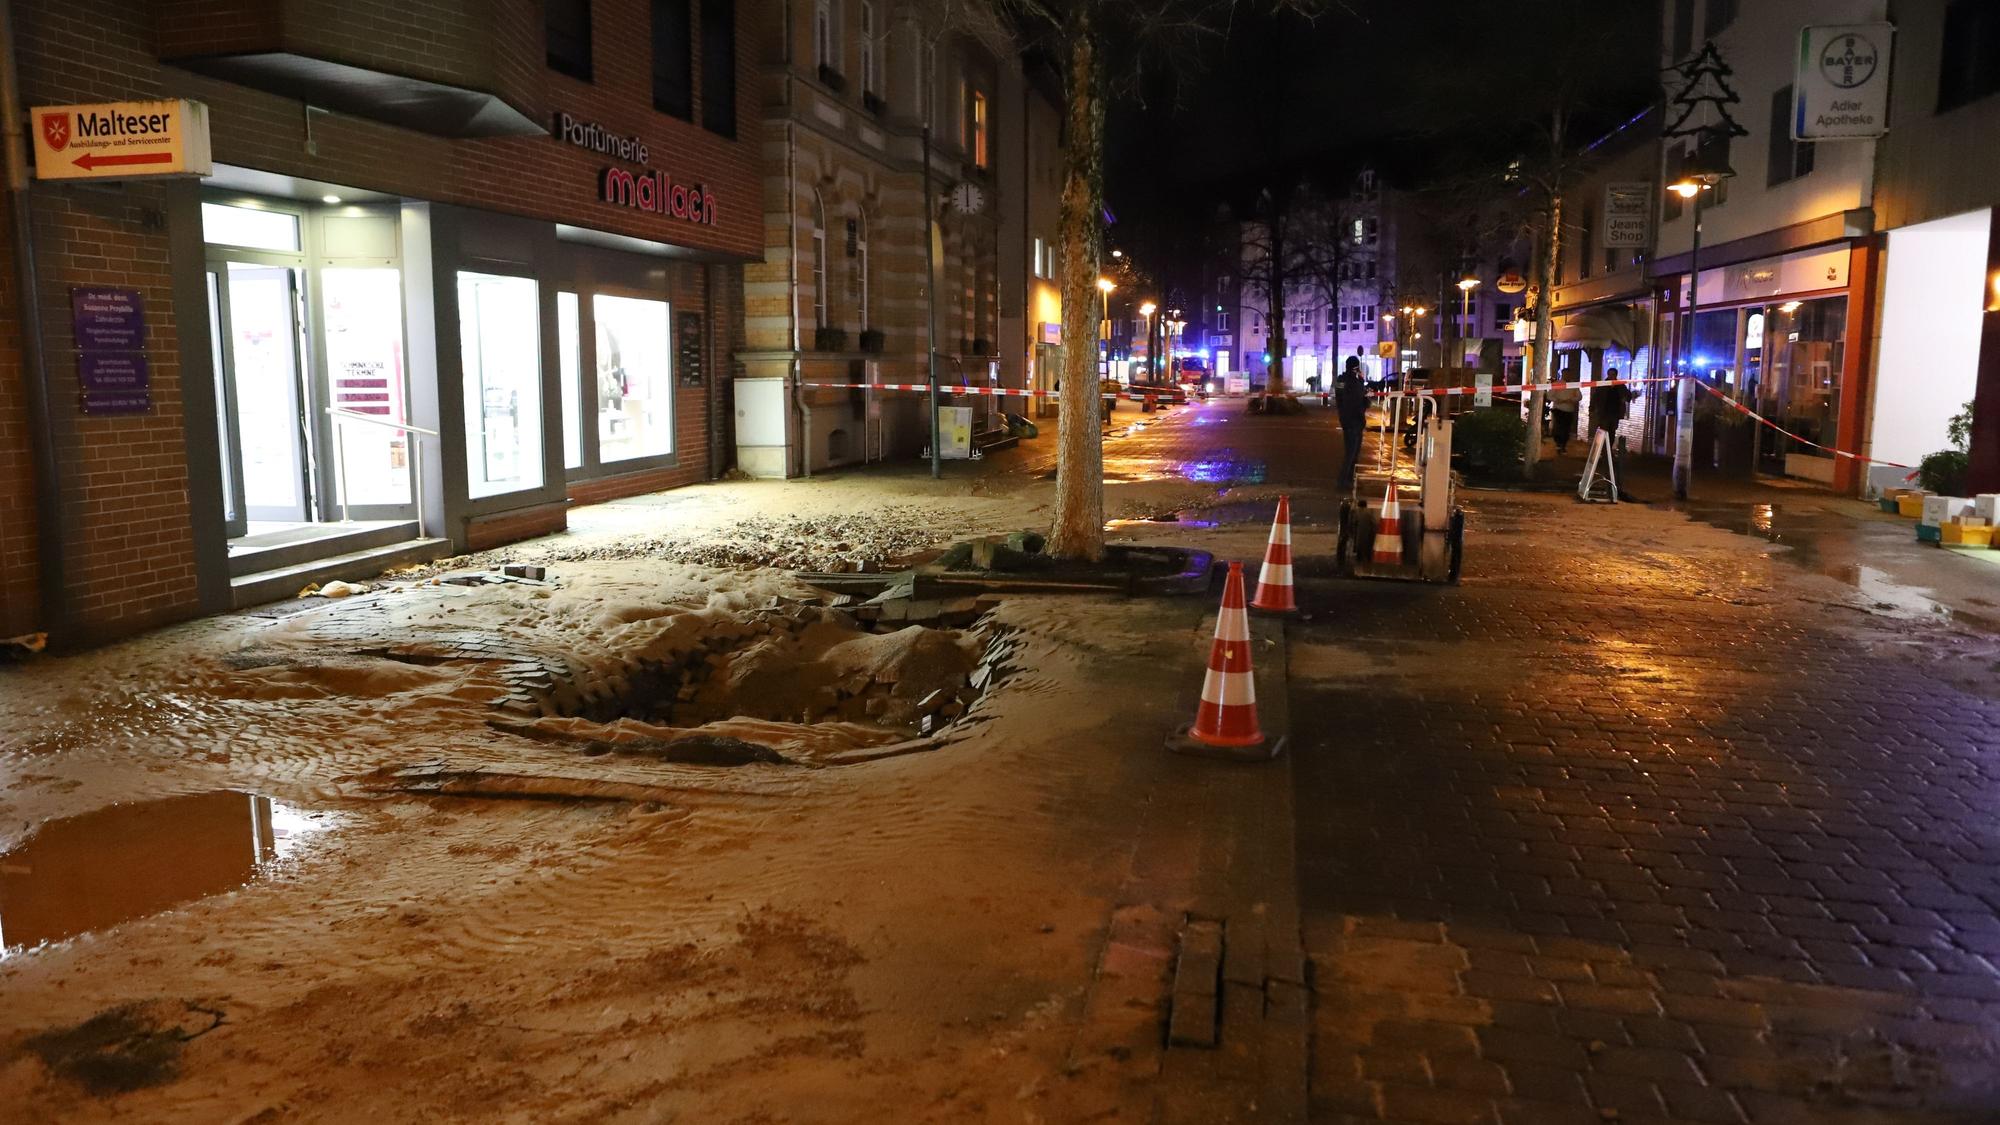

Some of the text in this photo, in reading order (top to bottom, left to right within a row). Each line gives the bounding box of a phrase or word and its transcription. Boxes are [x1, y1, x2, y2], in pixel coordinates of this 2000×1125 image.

[1825, 56, 1873, 66] BAYER
[1830, 101, 1863, 111] Adler
[77, 110, 170, 137] Malteser
[1815, 114, 1873, 128] Apotheke
[69, 136, 171, 149] Ausbildungs- und Servicecenter
[562, 113, 649, 164] Parfümerie
[605, 167, 717, 226] mallach
[1609, 219, 1645, 229] Jeans
[1611, 230, 1644, 242] Shop
